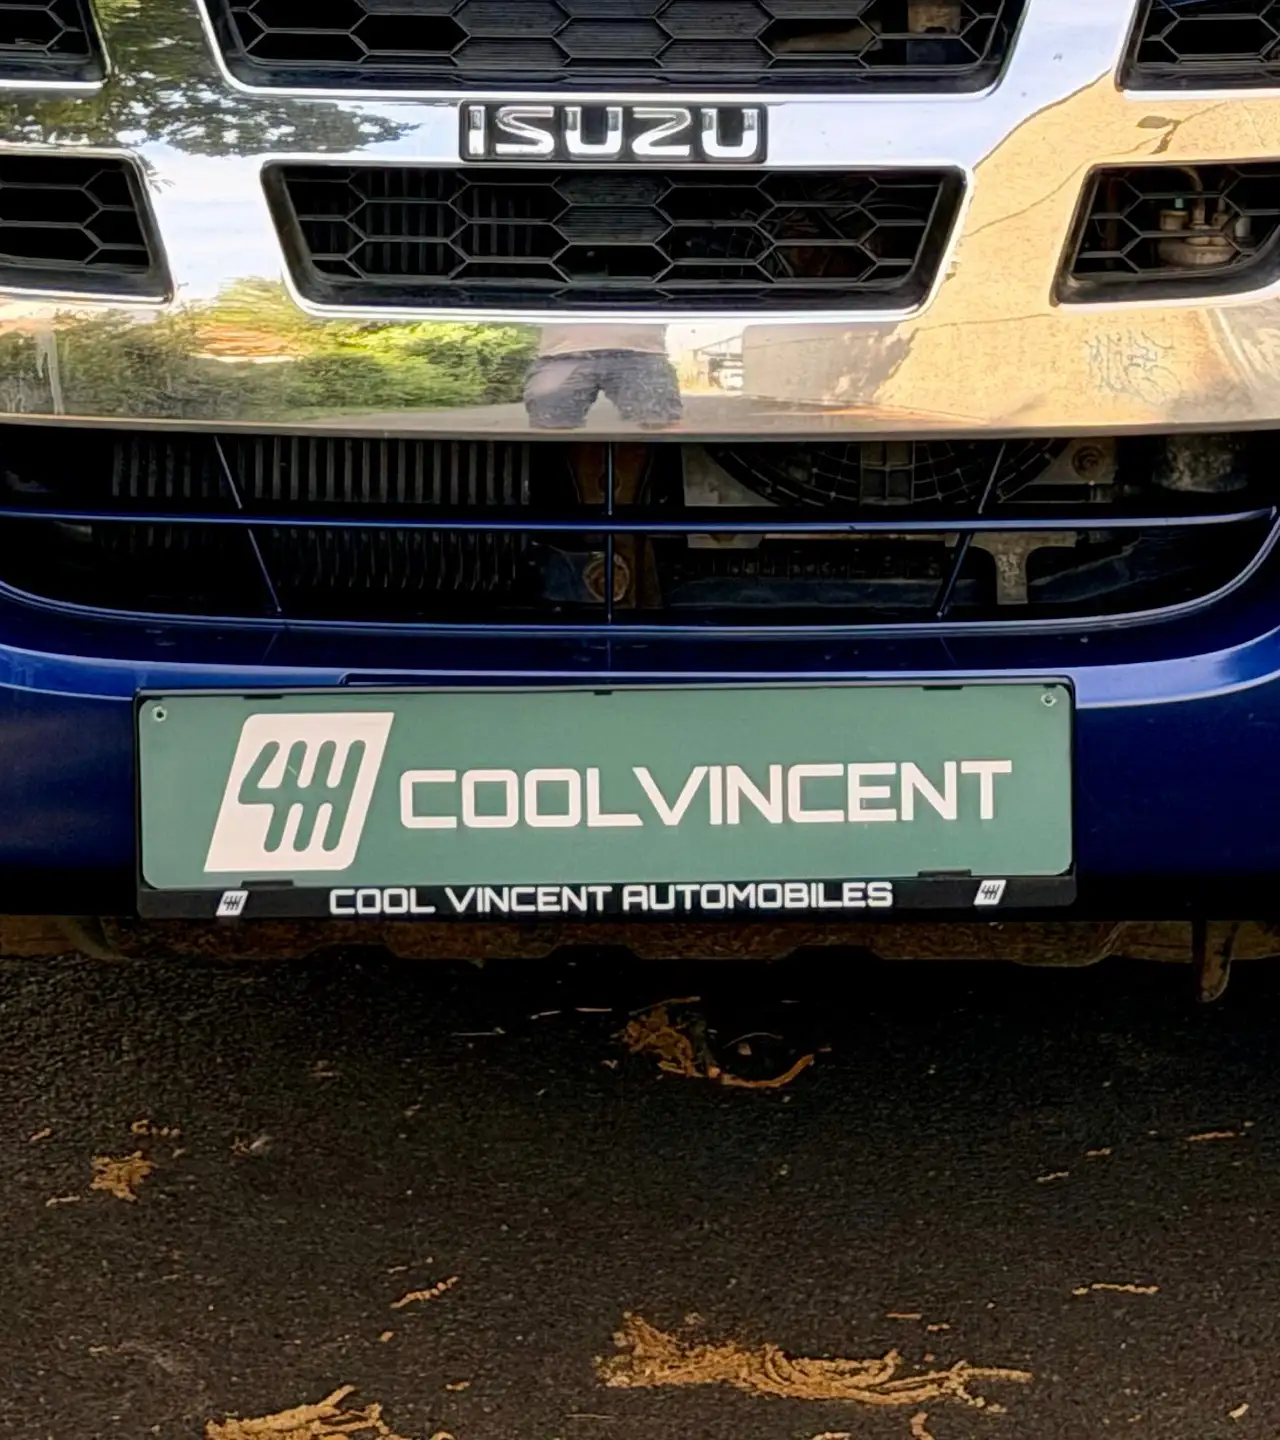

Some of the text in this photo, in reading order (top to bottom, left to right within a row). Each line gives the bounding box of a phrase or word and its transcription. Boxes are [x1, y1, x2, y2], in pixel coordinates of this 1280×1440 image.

[469, 105, 760, 159] ISUZU
[399, 759, 1013, 830] COOLVINCENT
[329, 881, 893, 915] COOL VINCENT AUTOMOBILES
